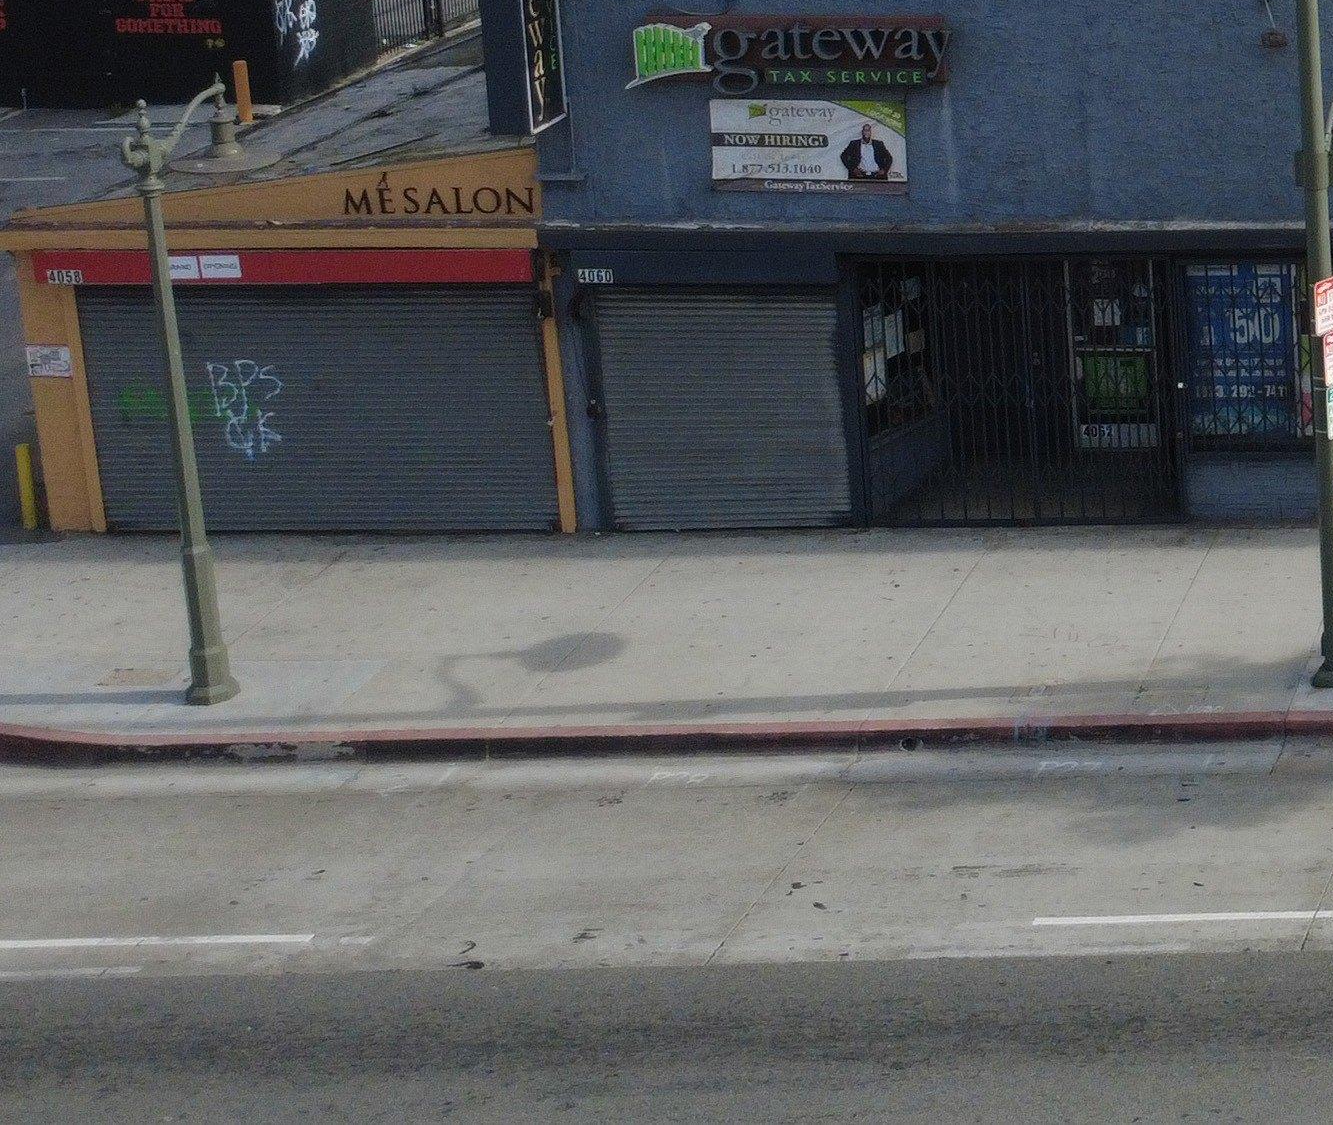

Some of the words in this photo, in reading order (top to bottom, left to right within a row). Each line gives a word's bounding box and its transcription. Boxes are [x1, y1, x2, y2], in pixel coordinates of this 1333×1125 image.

[149, 3, 185, 18] FOR
[115, 17, 223, 34] SOMETHING
[712, 23, 951, 94] gateway
[769, 70, 813, 84] TAX
[827, 70, 924, 84] SERVICE
[767, 102, 837, 126] gateway
[722, 134, 762, 147] NOW
[763, 135, 825, 148] HIRING!
[49, 270, 82, 285] 4058
[579, 269, 614, 284] 4060
